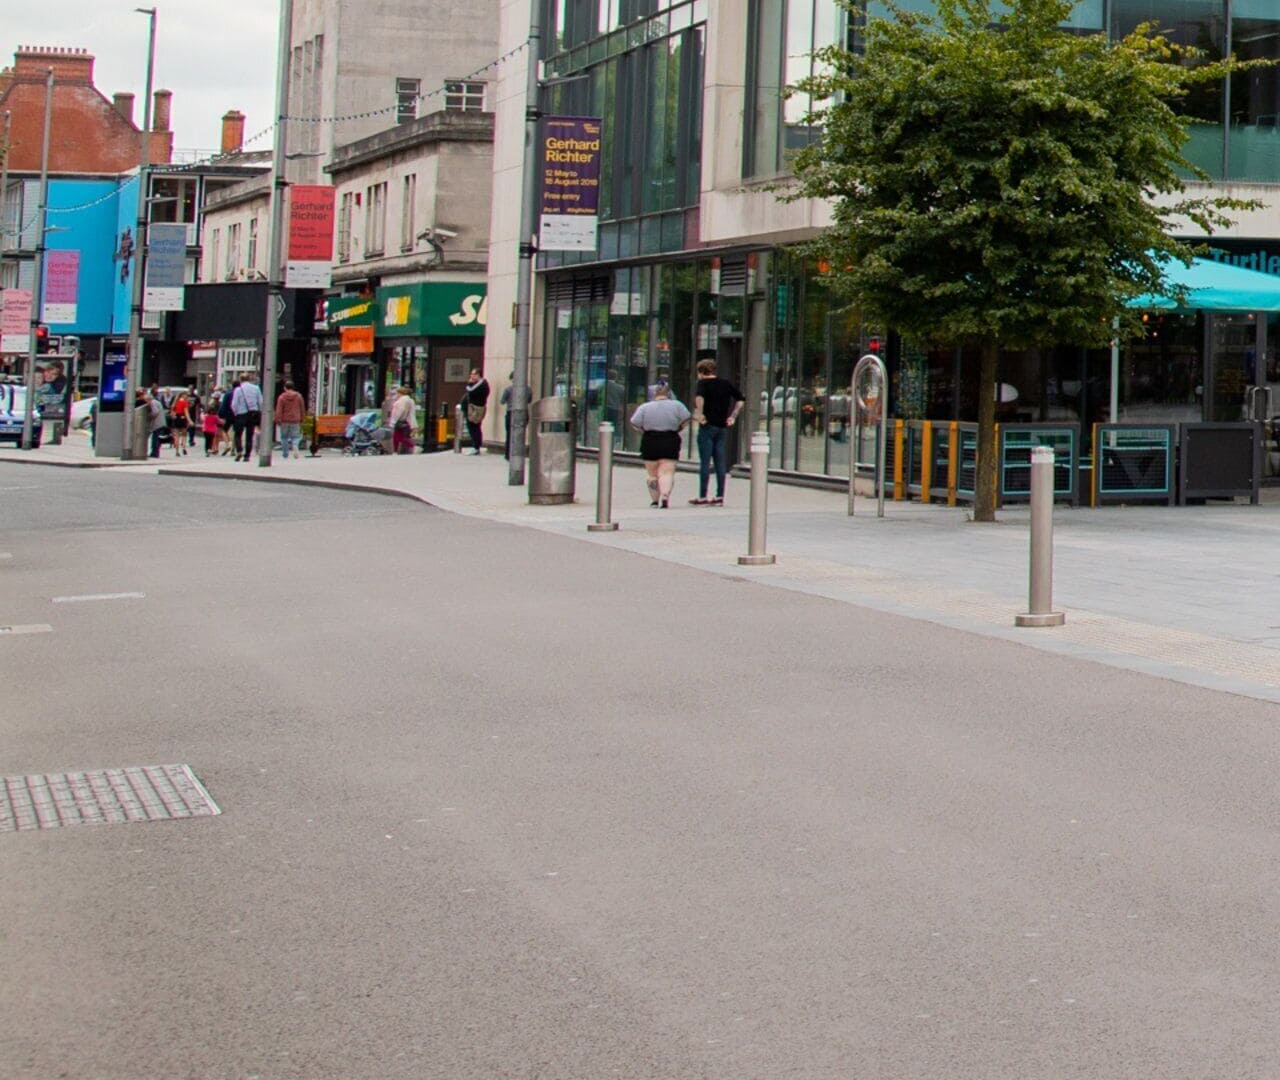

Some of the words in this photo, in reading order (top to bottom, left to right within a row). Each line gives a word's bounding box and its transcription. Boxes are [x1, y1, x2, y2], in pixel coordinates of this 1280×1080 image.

[546, 137, 600, 151] Gerhard
[546, 150, 593, 163] Richter
[554, 169, 569, 178] May
[554, 178, 579, 187] August
[544, 191, 560, 200] Free
[561, 193, 580, 202] entry
[291, 202, 333, 211] Gerhard
[291, 211, 328, 221] Richter
[330, 300, 372, 323] SUBWAY
